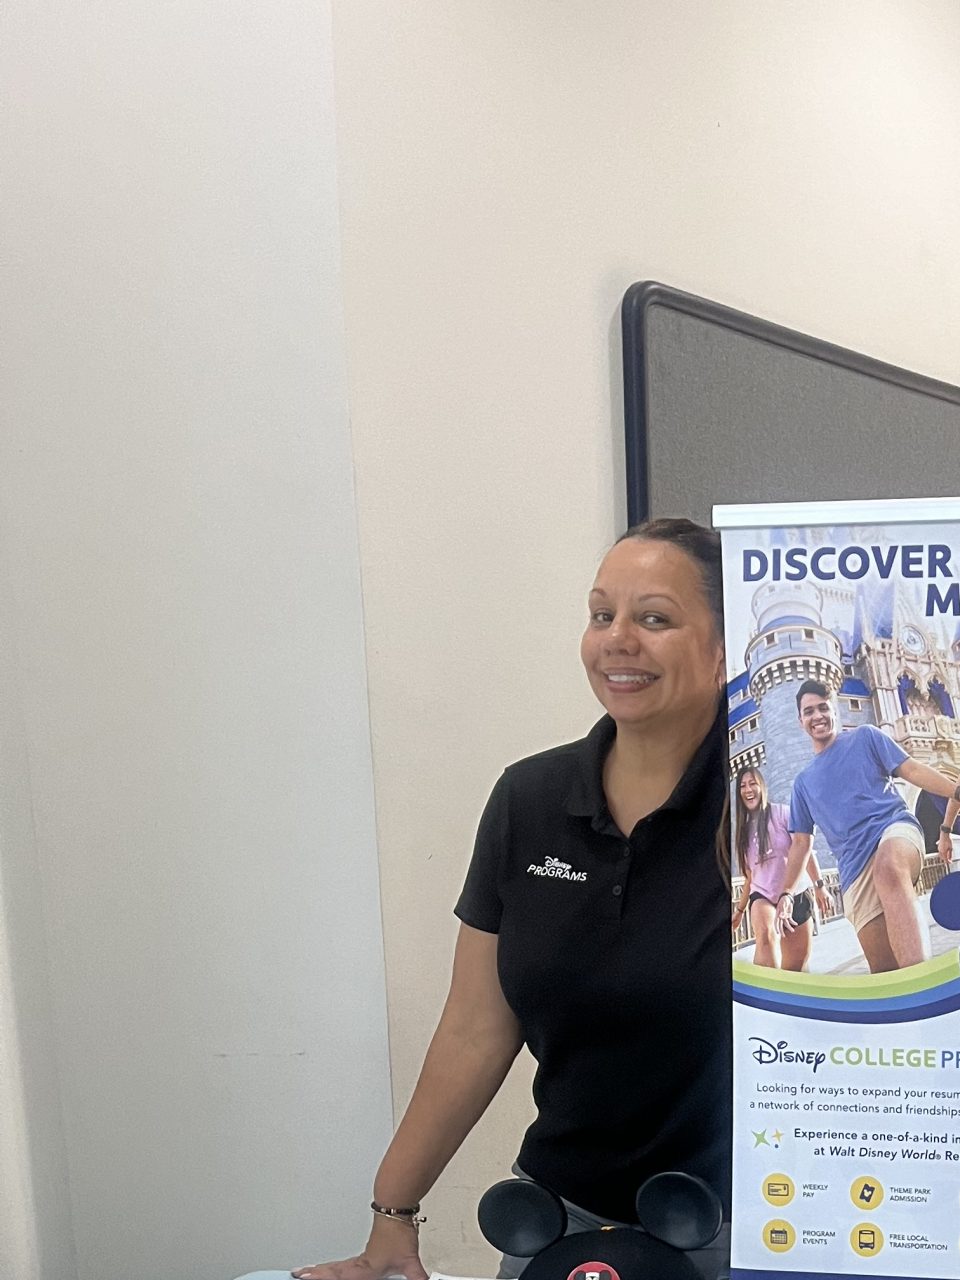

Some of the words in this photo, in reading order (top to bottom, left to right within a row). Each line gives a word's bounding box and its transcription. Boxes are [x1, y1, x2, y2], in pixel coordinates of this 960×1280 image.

[742, 544, 953, 582] DISCOVER
[526, 864, 588, 882] PROGRAMS
[748, 1037, 826, 1073] Disney
[829, 1046, 937, 1068] COLLEGE
[756, 1083, 797, 1096] Looking
[800, 1083, 816, 1094] for
[818, 1087, 845, 1097] ways
[847, 1087, 859, 1096] to
[862, 1086, 901, 1099] expand
[903, 1089, 927, 1100] your
[758, 1101, 800, 1111] network
[803, 1101, 814, 1111] of
[817, 1103, 880, 1114] connections
[882, 1104, 903, 1114] and
[794, 1128, 858, 1141] Experience
[861, 1132, 868, 1140] a
[871, 1131, 948, 1144] one-of-a-kind
[813, 1146, 825, 1156] at
[829, 1145, 855, 1157] Walt
[858, 1146, 898, 1161] Disney
[889, 1186, 912, 1195] THEME
[889, 1195, 928, 1203] ADMISSION
[889, 1233, 905, 1241] FREE
[889, 1241, 948, 1251] TRANSPORTATION
